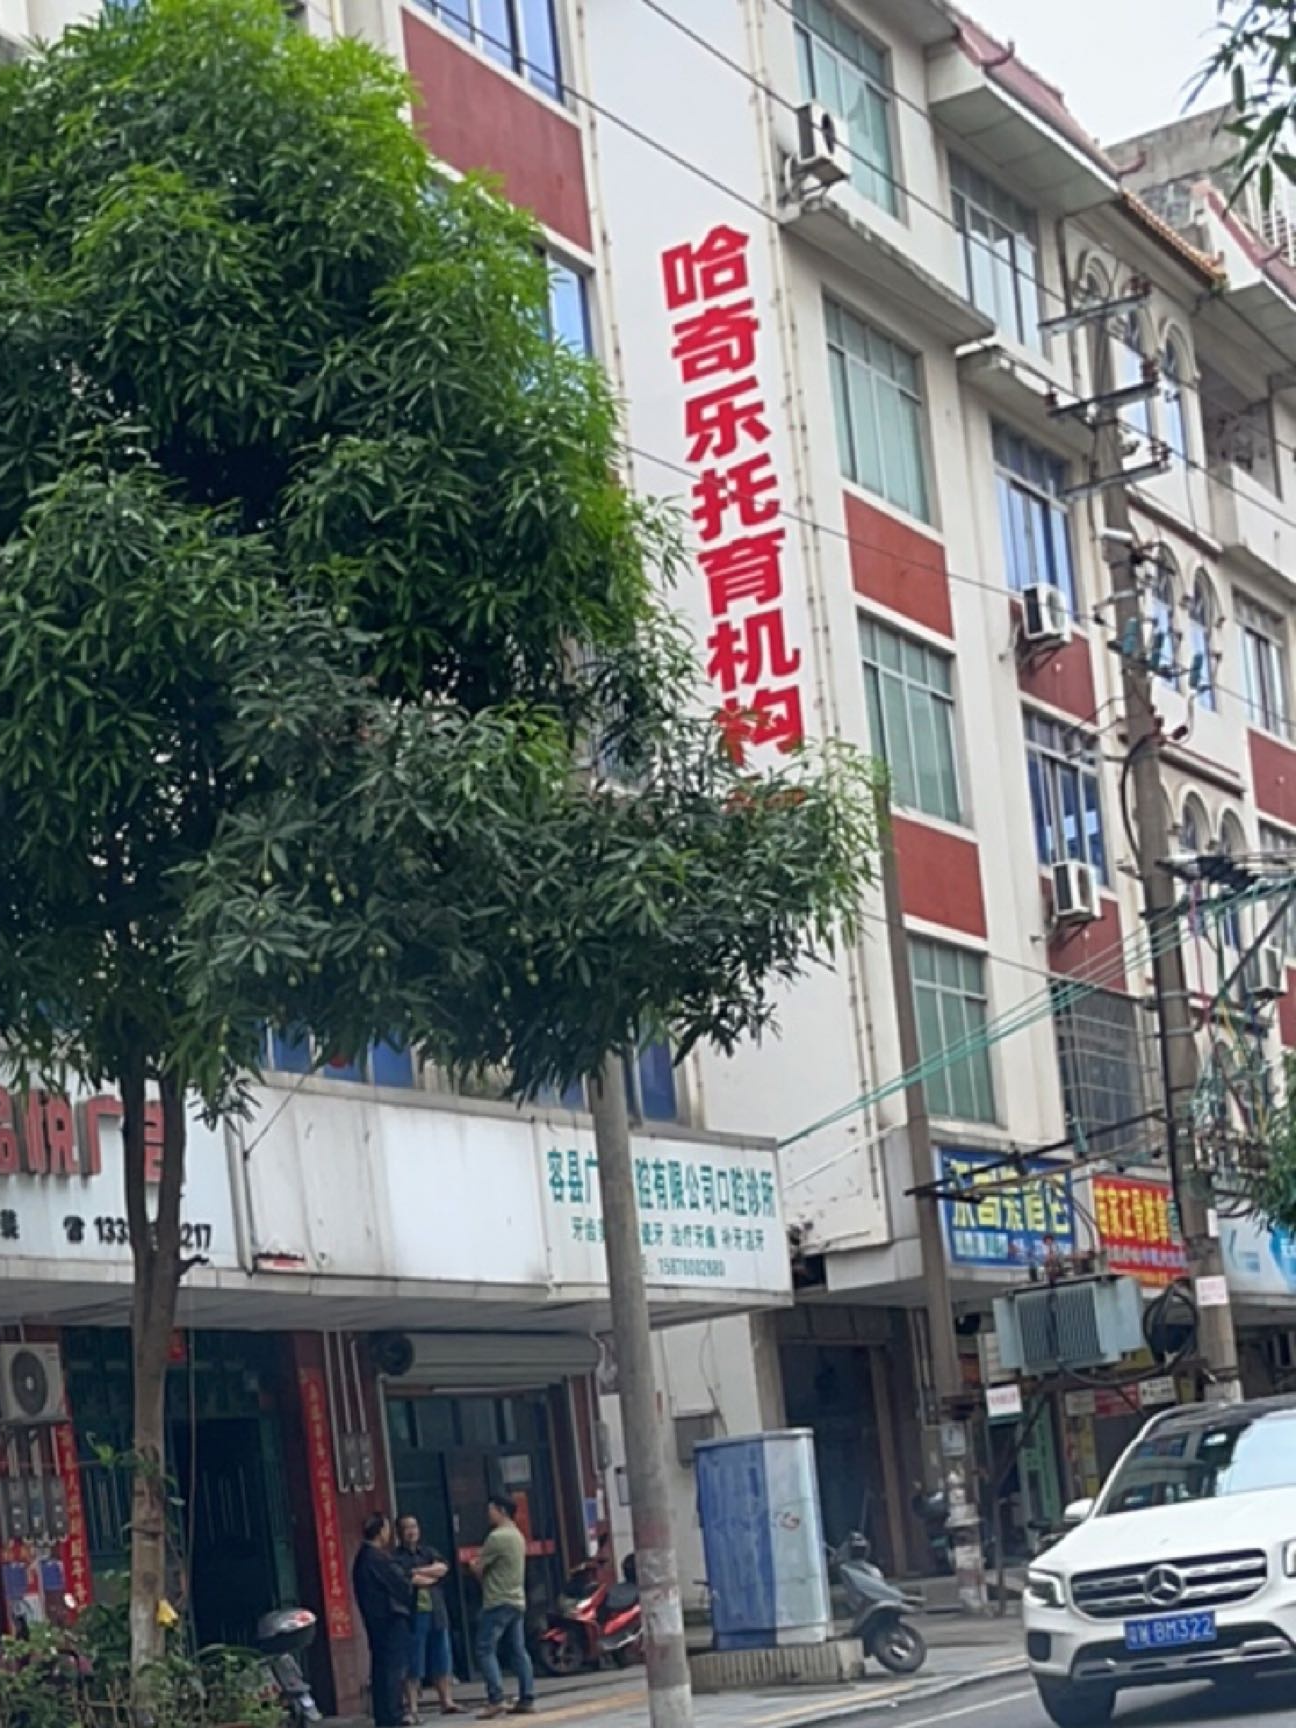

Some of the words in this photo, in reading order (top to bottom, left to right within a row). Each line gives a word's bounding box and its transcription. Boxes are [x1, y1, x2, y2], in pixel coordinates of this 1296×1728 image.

[661, 224, 805, 766] 哈奇乐托育机构
